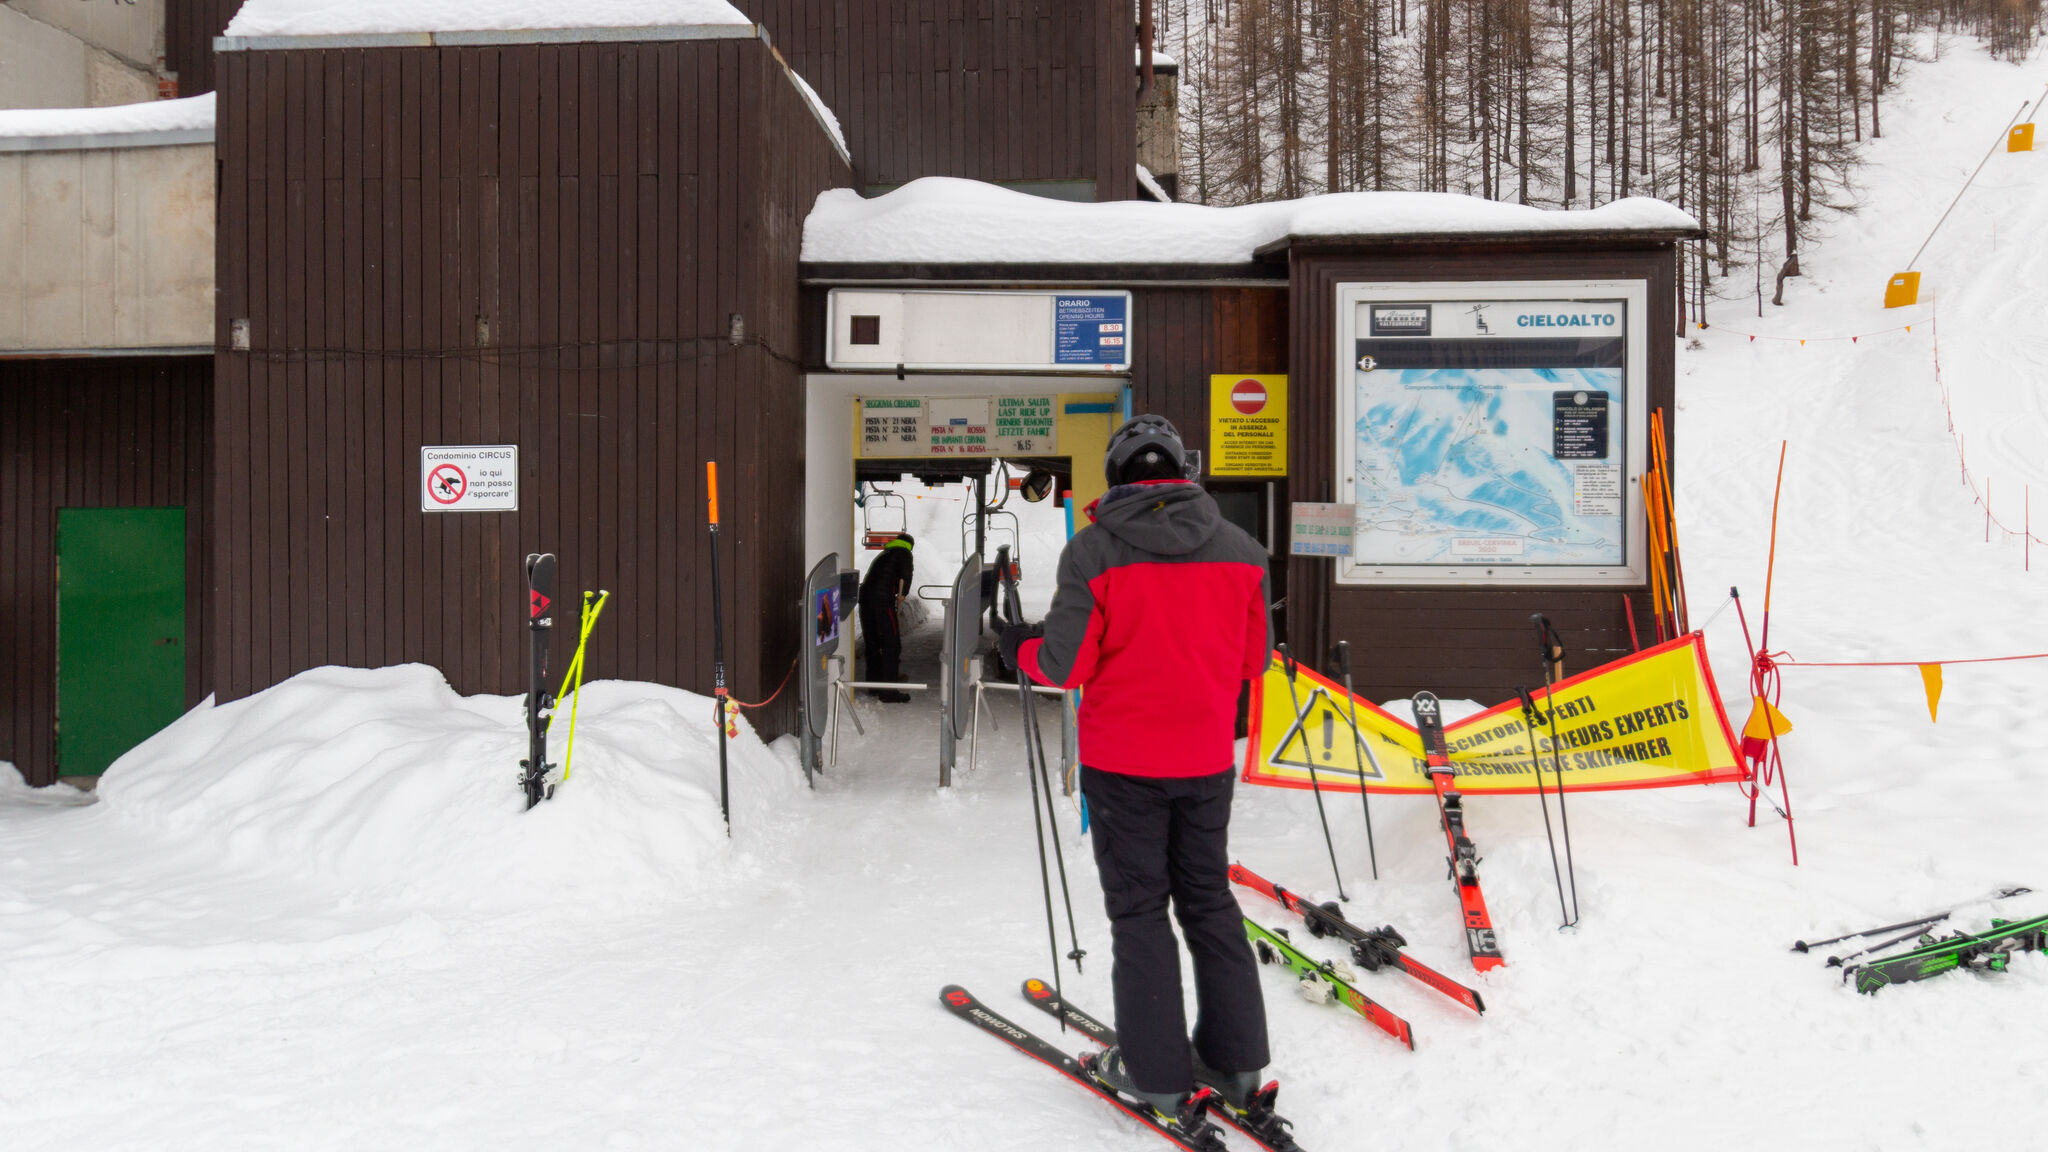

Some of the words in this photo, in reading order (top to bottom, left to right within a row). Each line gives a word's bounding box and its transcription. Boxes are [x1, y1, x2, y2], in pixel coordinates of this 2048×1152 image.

[1516, 313, 1615, 327] CIELOALTO
[998, 398, 1025, 407] ULTIMA
[1028, 398, 1050, 407] SALITA
[998, 408, 1016, 416] LAST
[1019, 408, 1036, 416] RIDE
[1039, 408, 1050, 416] UP
[865, 417, 881, 425] PISTA
[900, 417, 917, 425] NERA
[865, 426, 881, 434] PISTA
[900, 426, 917, 434] NERA
[930, 426, 946, 434] PISTA
[967, 426, 986, 434] ROSSA
[998, 427, 1024, 436] LETZTE
[1027, 427, 1051, 436] FAHRT
[865, 435, 881, 443] PISTA
[900, 435, 917, 443] NERA
[964, 435, 986, 444] CERVINIA
[930, 445, 946, 453] PISTA
[967, 445, 986, 453] ROSSA
[427, 452, 477, 460] Condominio
[489, 469, 502, 478] qui
[1614, 698, 1689, 737] EXPERTS
[1446, 720, 1525, 754] SCIATORI
[1412, 754, 1574, 777] FGESCHRITENE
[1573, 736, 1672, 770] SKIFAHRER
[1049, 1001, 1104, 1033] SALOMN
[968, 1008, 1028, 1040] SALOMON
